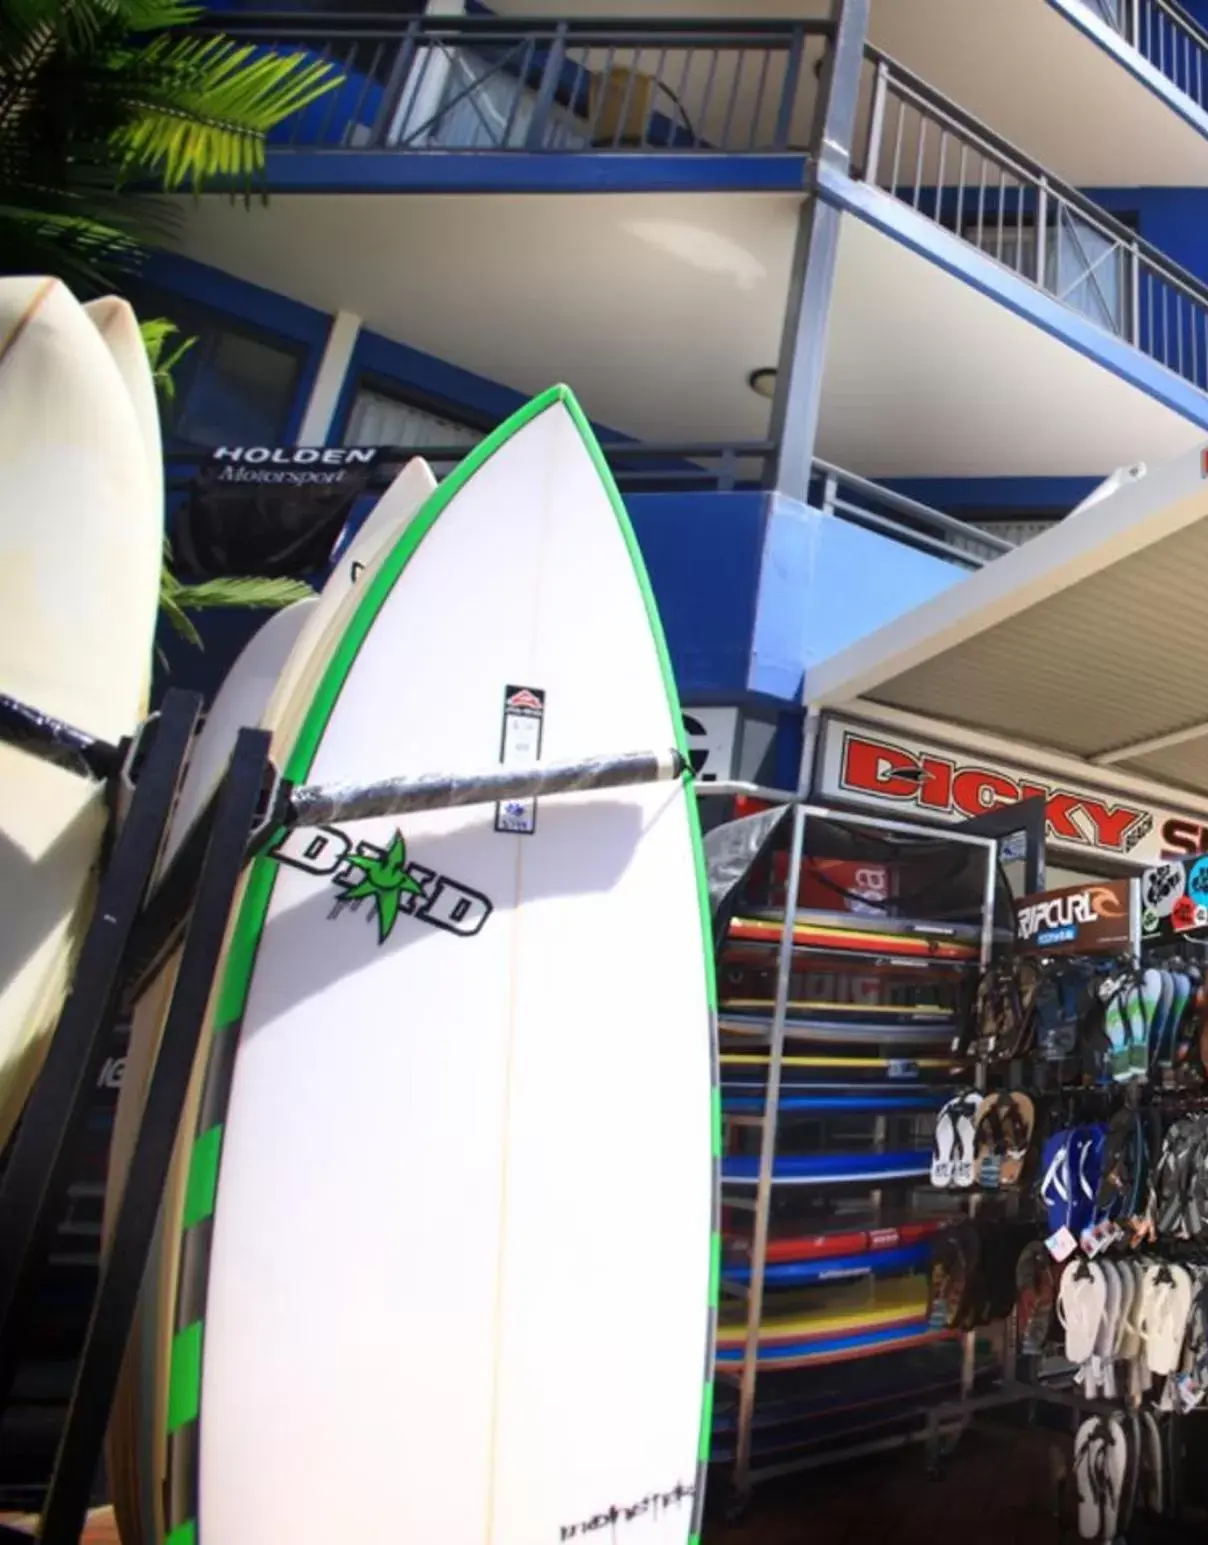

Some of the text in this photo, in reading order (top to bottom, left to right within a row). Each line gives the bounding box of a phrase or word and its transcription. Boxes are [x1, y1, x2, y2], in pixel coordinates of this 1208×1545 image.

[213, 446, 377, 465] HOLDEN
[217, 464, 348, 487] Motorsport
[840, 730, 1151, 854] DICKY
